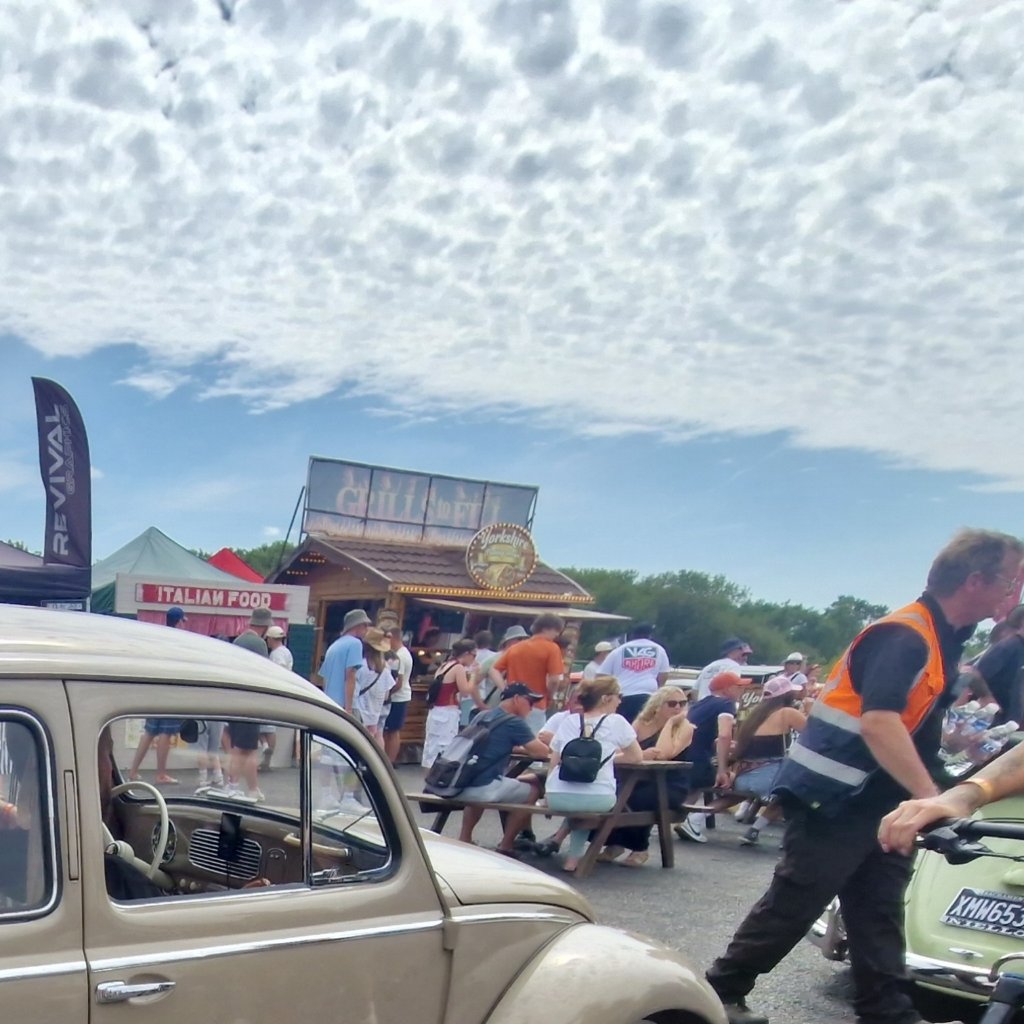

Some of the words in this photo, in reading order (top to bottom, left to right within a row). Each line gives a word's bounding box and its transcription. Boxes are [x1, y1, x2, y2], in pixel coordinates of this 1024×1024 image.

[45, 404, 69, 556] REVIVAL
[480, 528, 529, 550] Yorkshire
[157, 586, 224, 607] ITALIAN
[227, 592, 272, 609] FOOD
